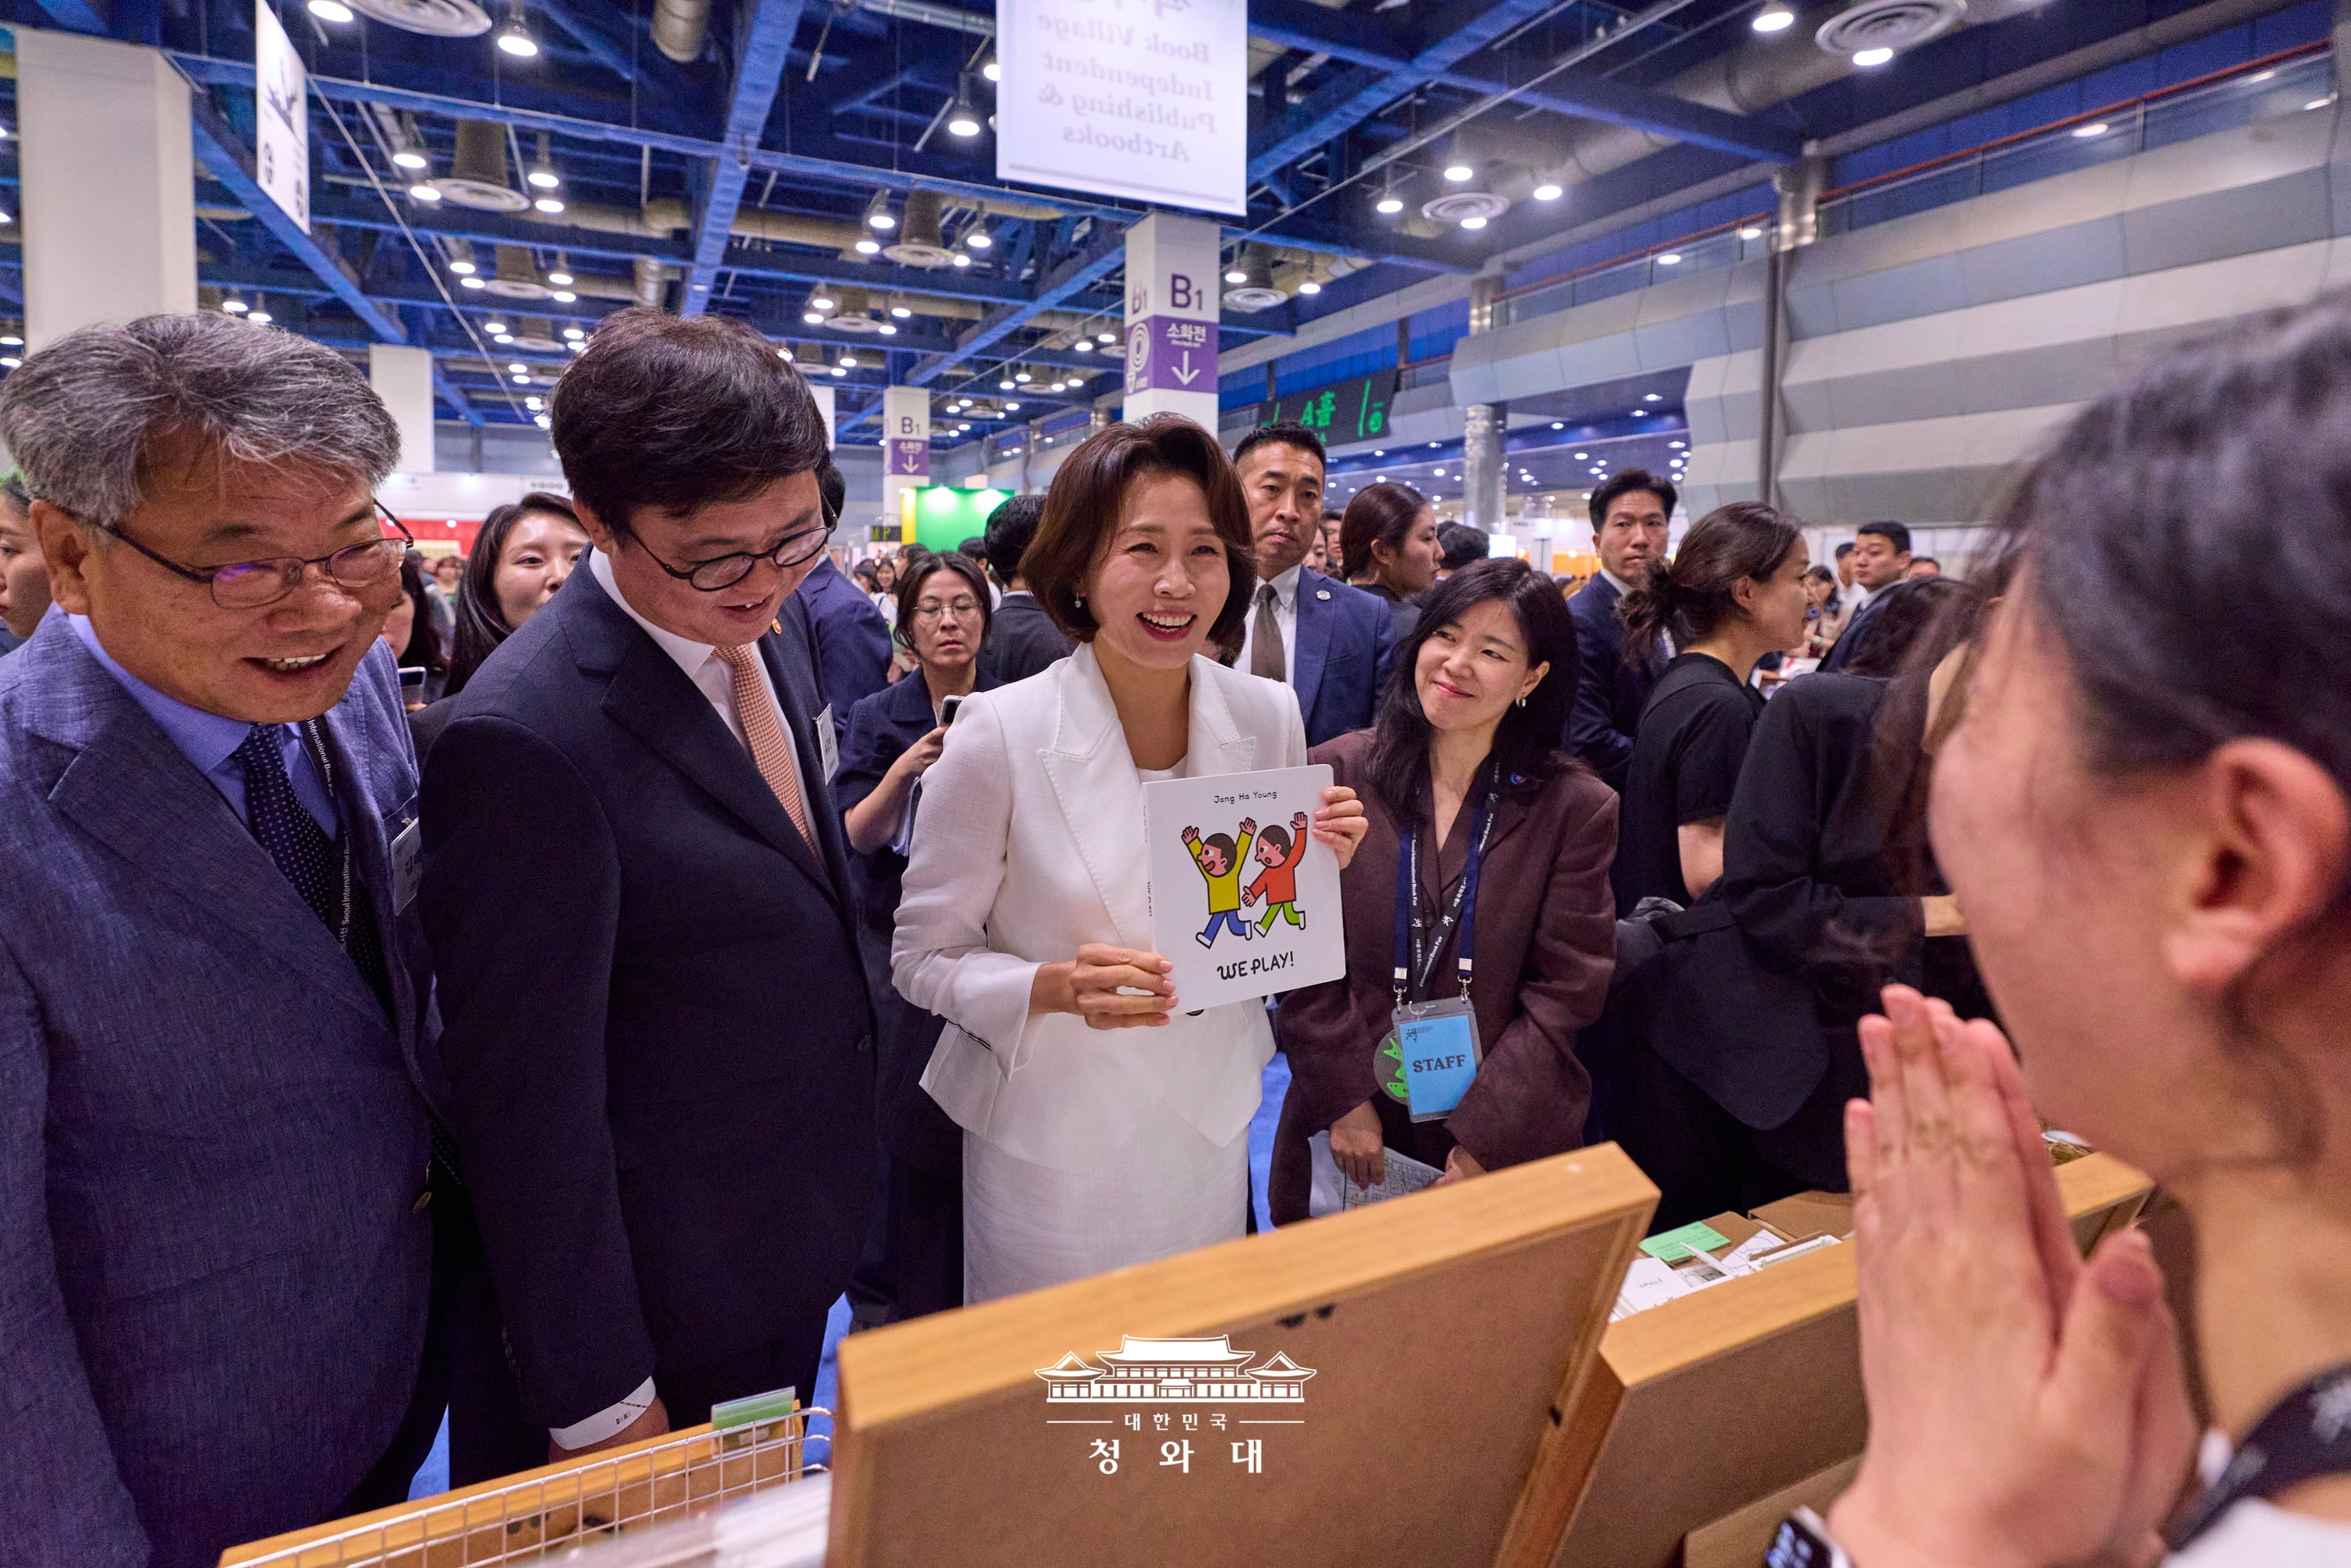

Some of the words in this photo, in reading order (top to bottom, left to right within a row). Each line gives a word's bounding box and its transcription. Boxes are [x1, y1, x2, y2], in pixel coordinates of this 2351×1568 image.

[1171, 274, 1202, 310] B1
[1166, 323, 1207, 343] 소화전
[902, 416, 920, 434] B1
[307, 719, 330, 763] International
[324, 763, 332, 783] Book
[1214, 795, 1235, 805] Jang
[1253, 791, 1277, 799] Young
[342, 856, 351, 903] International
[342, 903, 350, 925] Seoul
[1217, 961, 1248, 980] WE
[1251, 951, 1295, 975] PLAY!
[1413, 1055, 1465, 1073] STAFF
